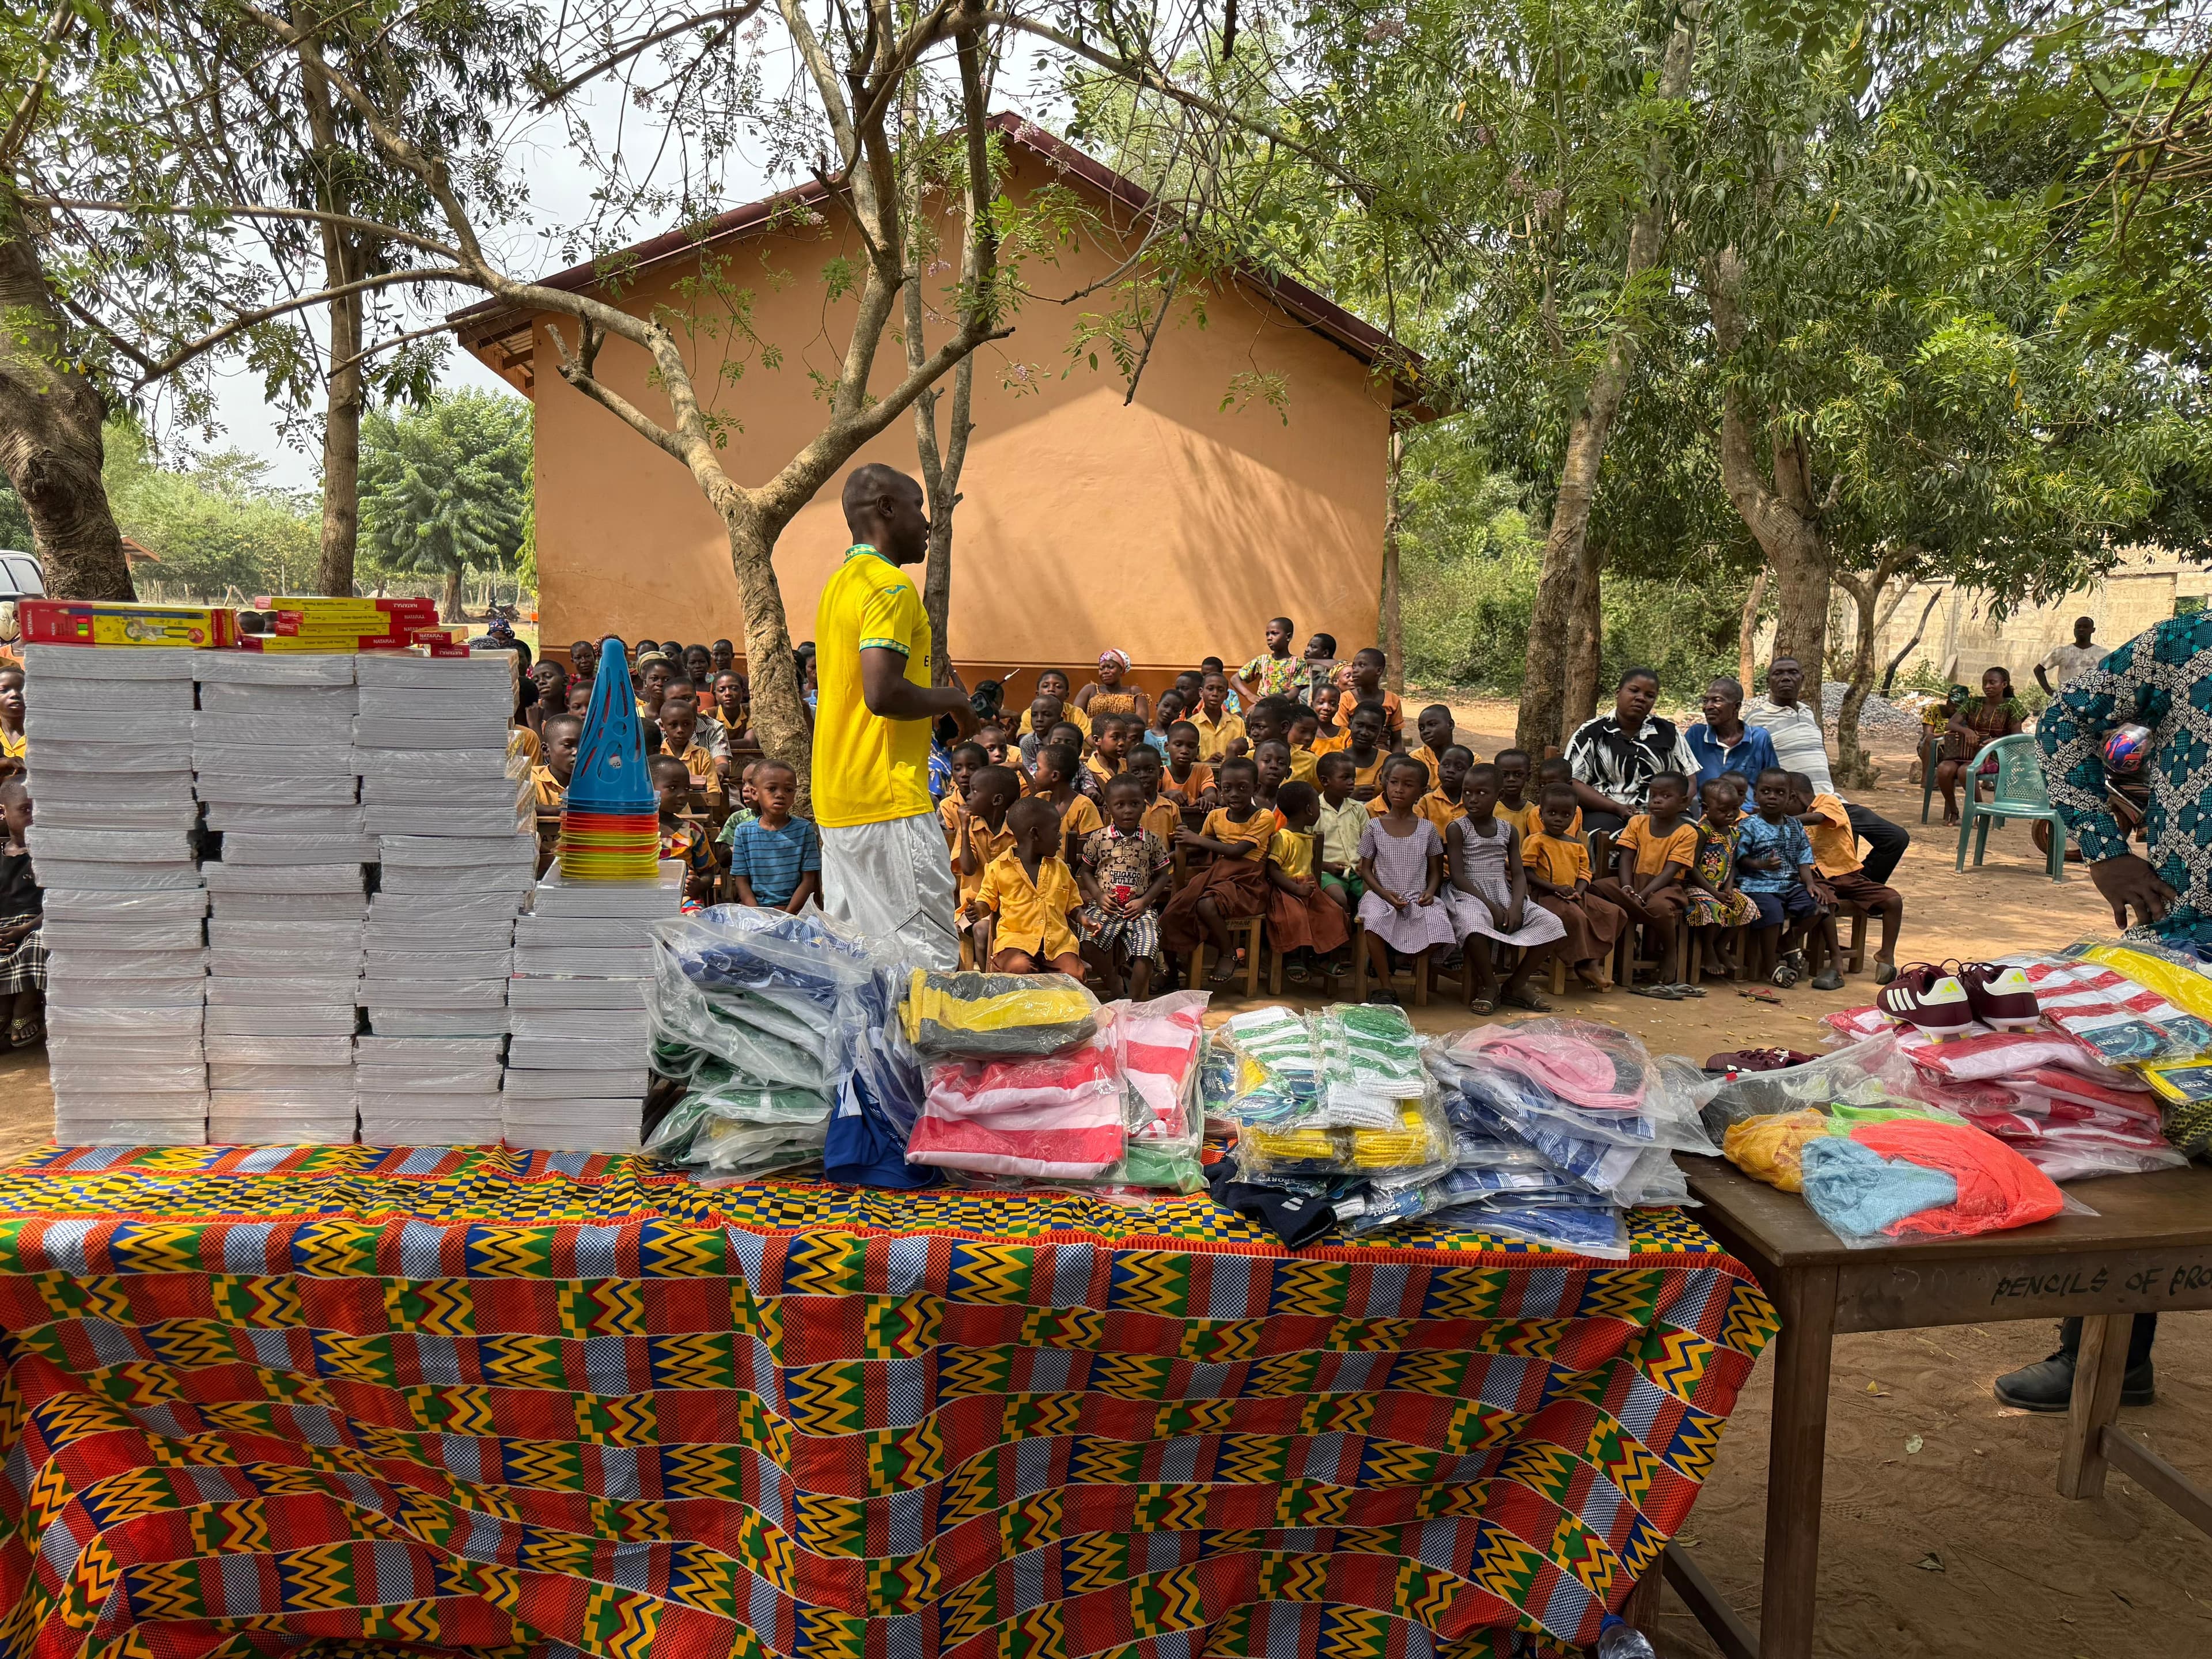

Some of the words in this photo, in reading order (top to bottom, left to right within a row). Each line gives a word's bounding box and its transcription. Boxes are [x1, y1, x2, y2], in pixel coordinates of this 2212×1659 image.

[1215, 1076, 1227, 1094] SPORT
[2177, 1080, 2209, 1089] SPORT
[1373, 1202, 1402, 1218] SPORT
[1990, 1267, 2109, 1306] PENCILS
[2124, 1267, 2164, 1294] OF
[2169, 1264, 2212, 1297] PRO
